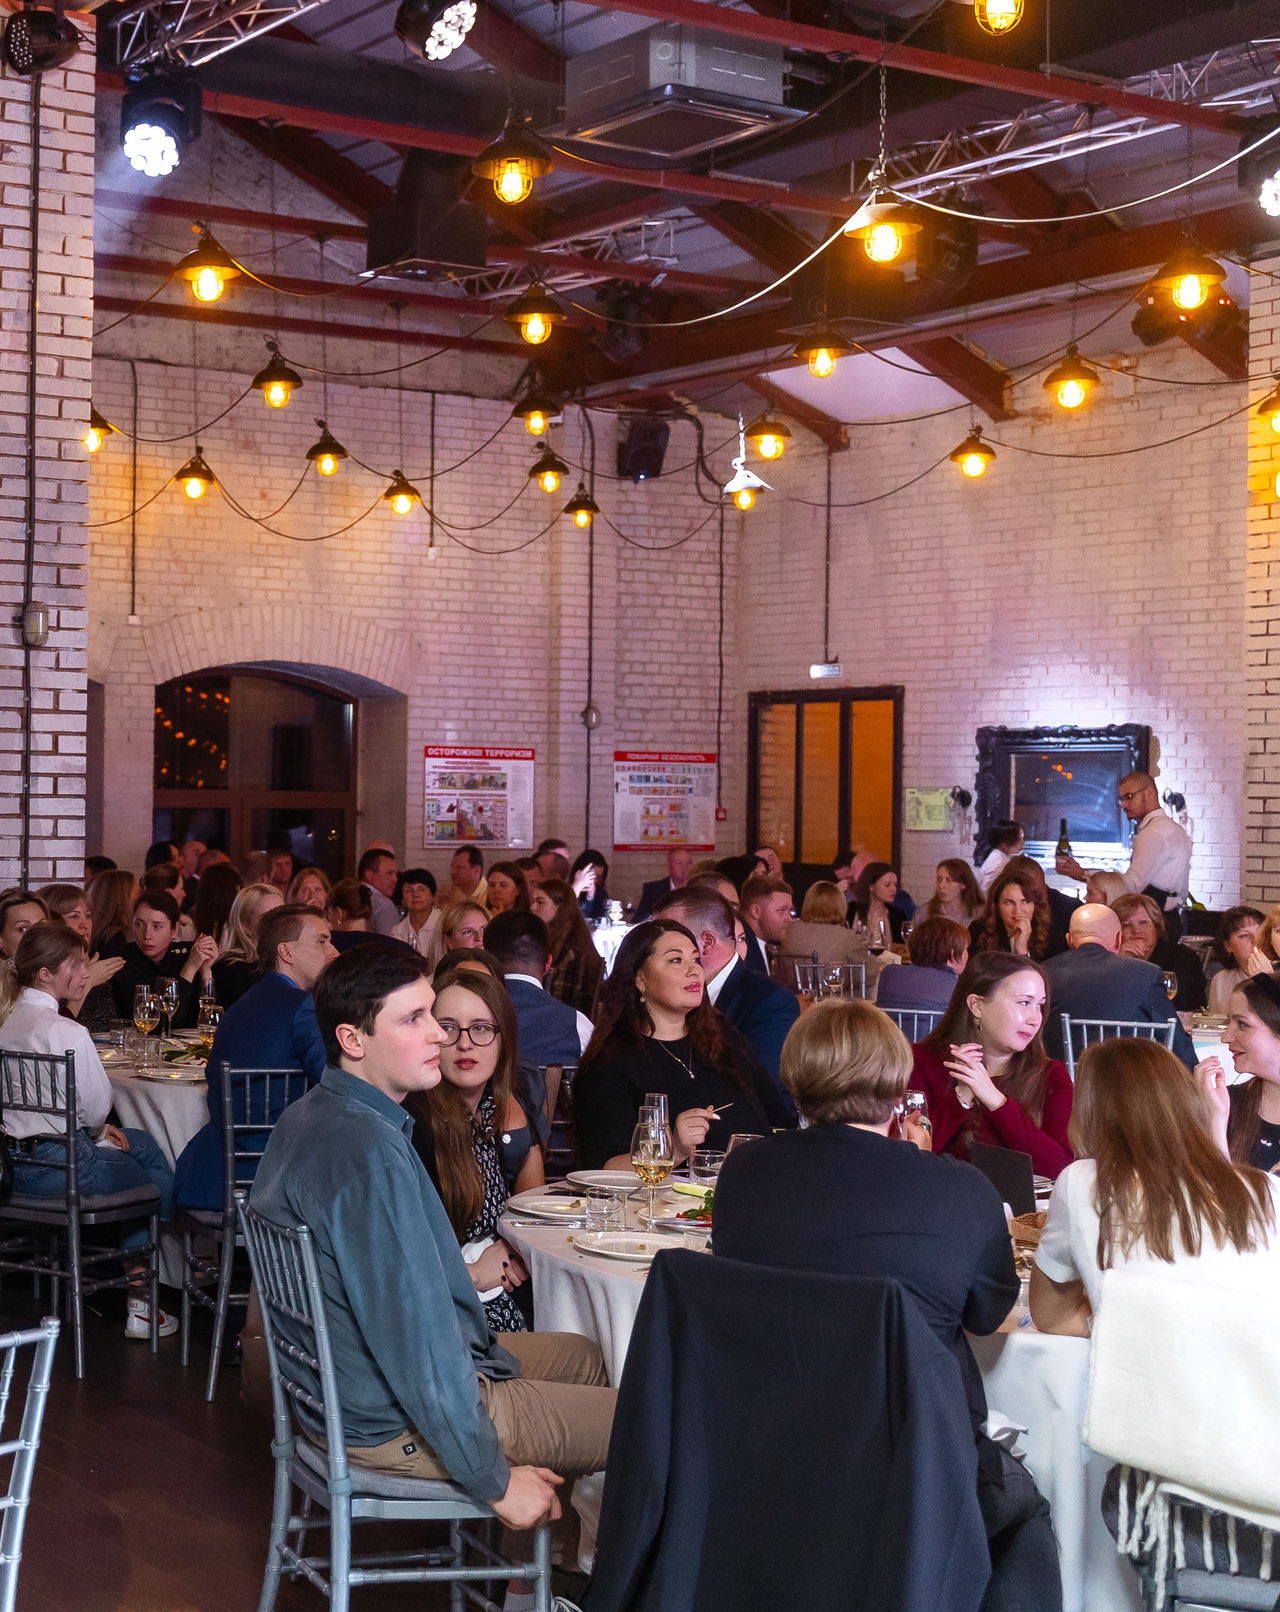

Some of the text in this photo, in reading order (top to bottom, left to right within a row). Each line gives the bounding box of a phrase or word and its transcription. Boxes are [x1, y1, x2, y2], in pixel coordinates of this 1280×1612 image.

[427, 747, 533, 758] ОСТОРОЖНО! ТЕРРОРИЗМ
[626, 752, 706, 761] ПОЖАРНАЯ БЕЗОПАСНОСТЬ
